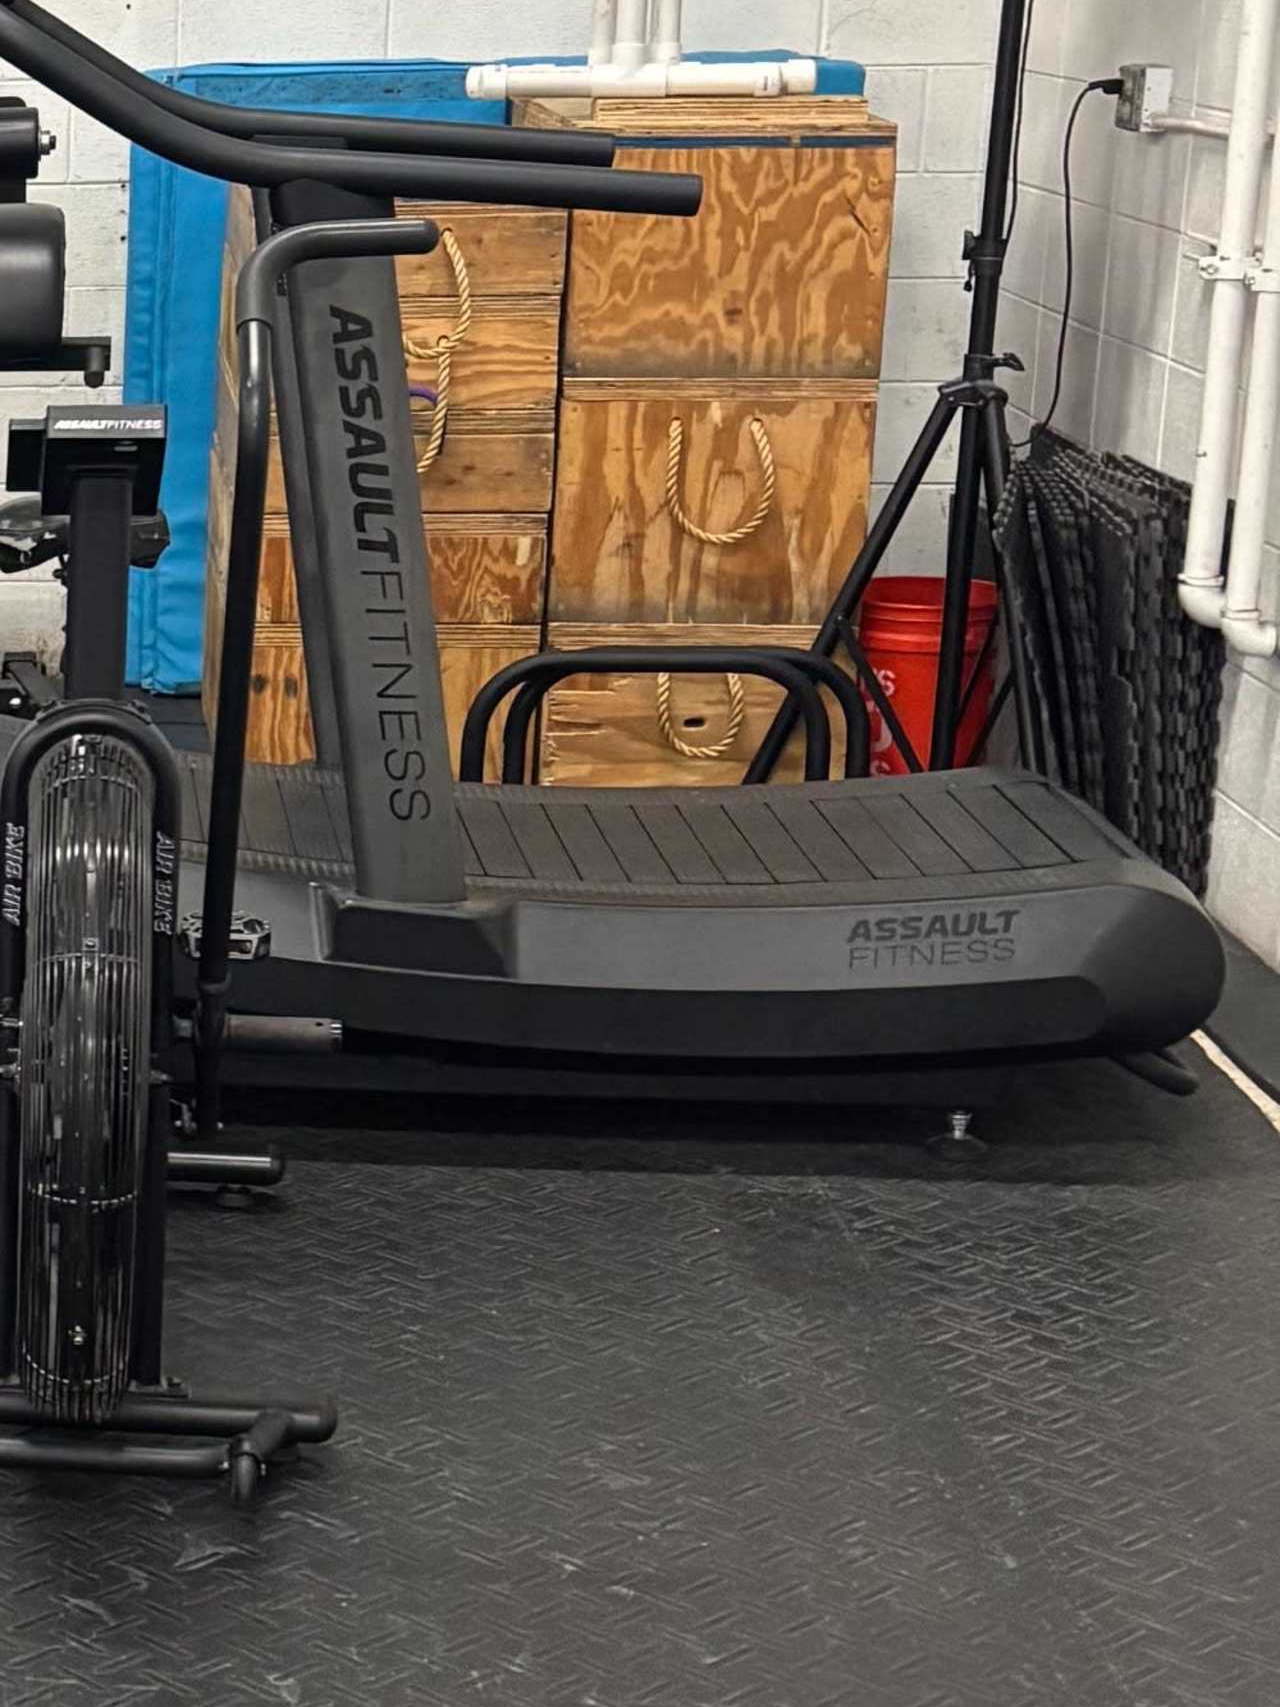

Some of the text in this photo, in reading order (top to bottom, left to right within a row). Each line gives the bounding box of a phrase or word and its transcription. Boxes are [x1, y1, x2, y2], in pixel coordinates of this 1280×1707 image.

[2, 822, 25, 926] AIR BIKE
[154, 831, 176, 935] AIR BIKE
[847, 909, 1021, 944] ASSAULT
[849, 937, 1017, 970] FITNESS
